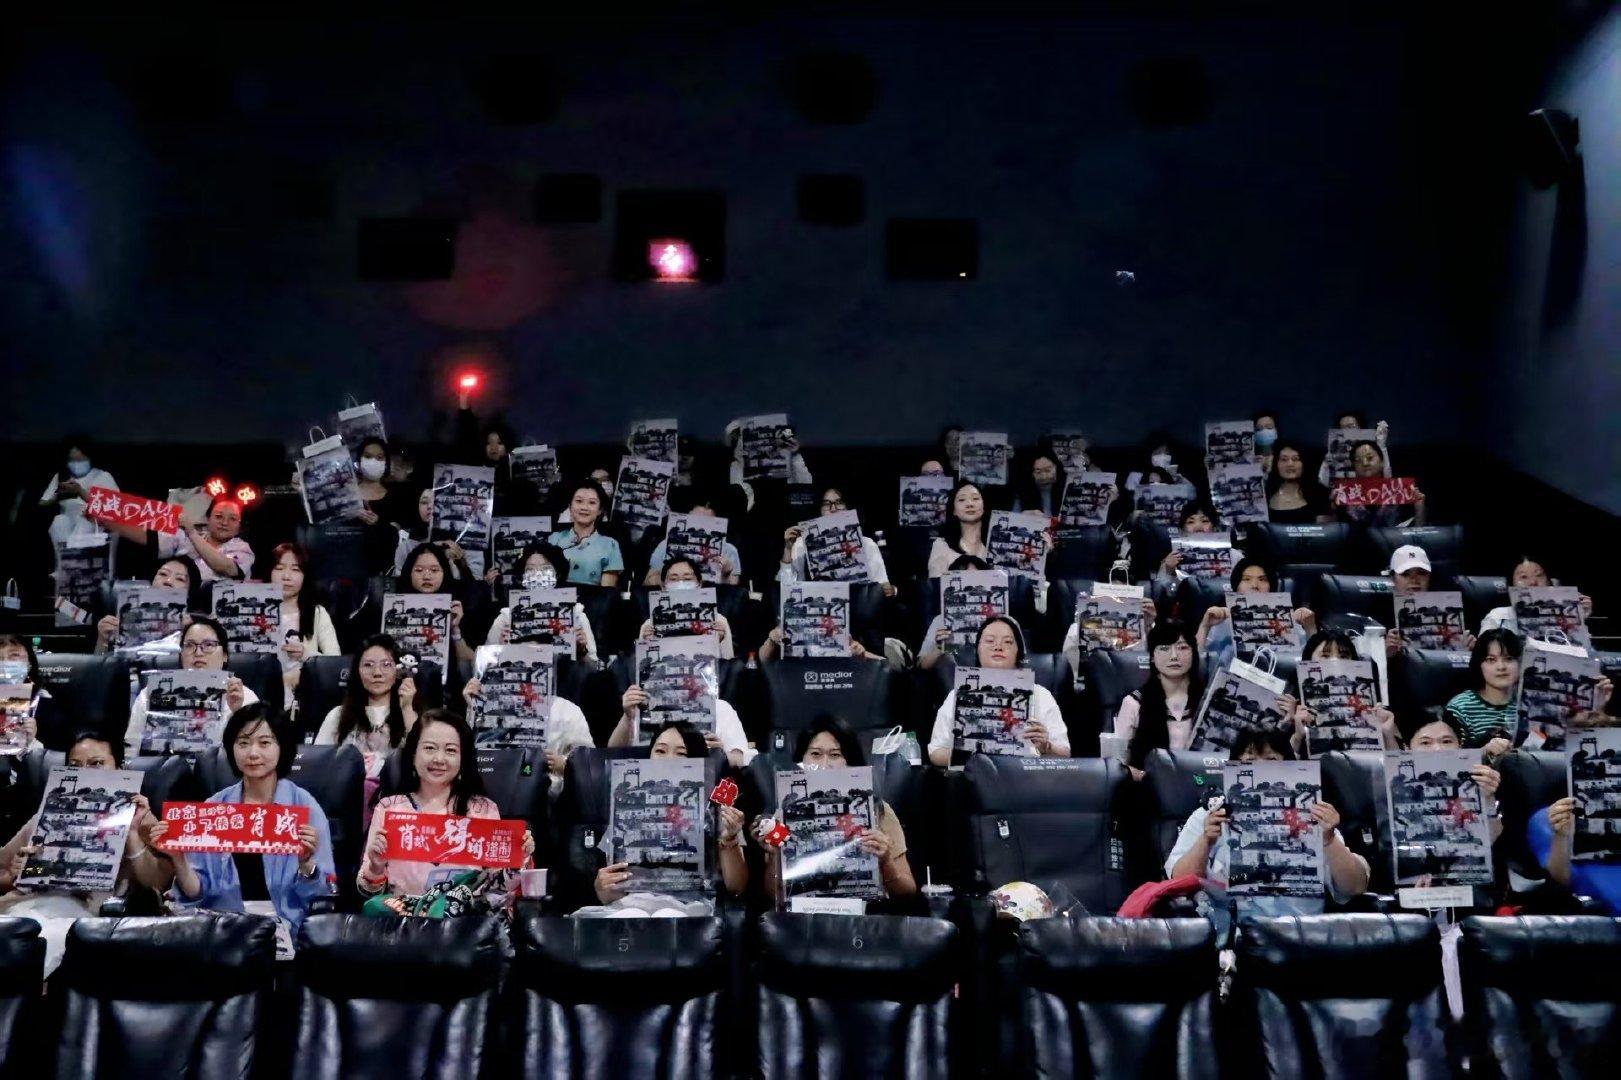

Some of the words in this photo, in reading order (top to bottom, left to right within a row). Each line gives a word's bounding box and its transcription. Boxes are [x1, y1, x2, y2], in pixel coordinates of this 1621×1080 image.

[88, 491, 122, 517] 肖战
[523, 765, 531, 775] 4
[166, 805, 197, 821] 北京
[250, 806, 300, 841] 肖战
